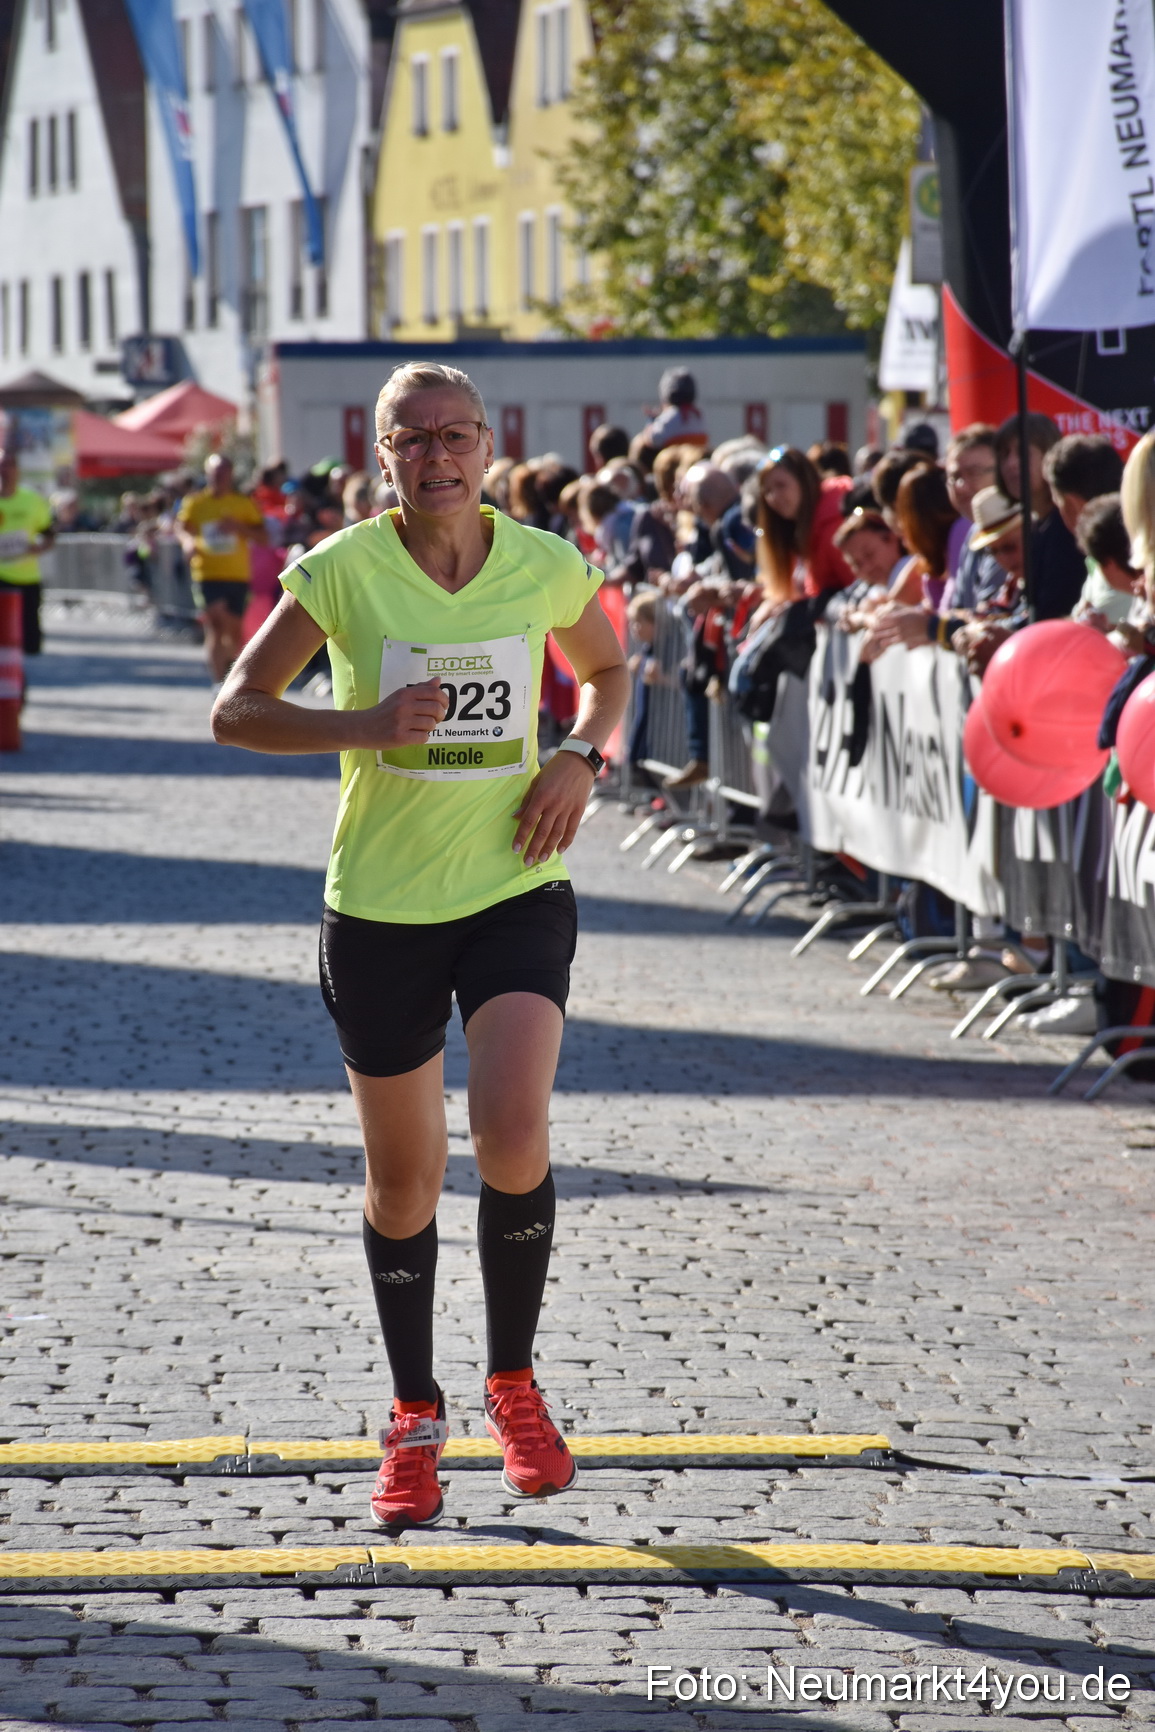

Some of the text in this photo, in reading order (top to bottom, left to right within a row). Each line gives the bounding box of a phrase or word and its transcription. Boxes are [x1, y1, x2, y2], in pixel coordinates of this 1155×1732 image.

[427, 655, 493, 671] BOCK
[406, 680, 511, 722] 023
[427, 728, 489, 737] TL Neumarkt
[428, 748, 483, 765] Nicole
[504, 1222, 552, 1241] adidas
[375, 1272, 420, 1284] adidas
